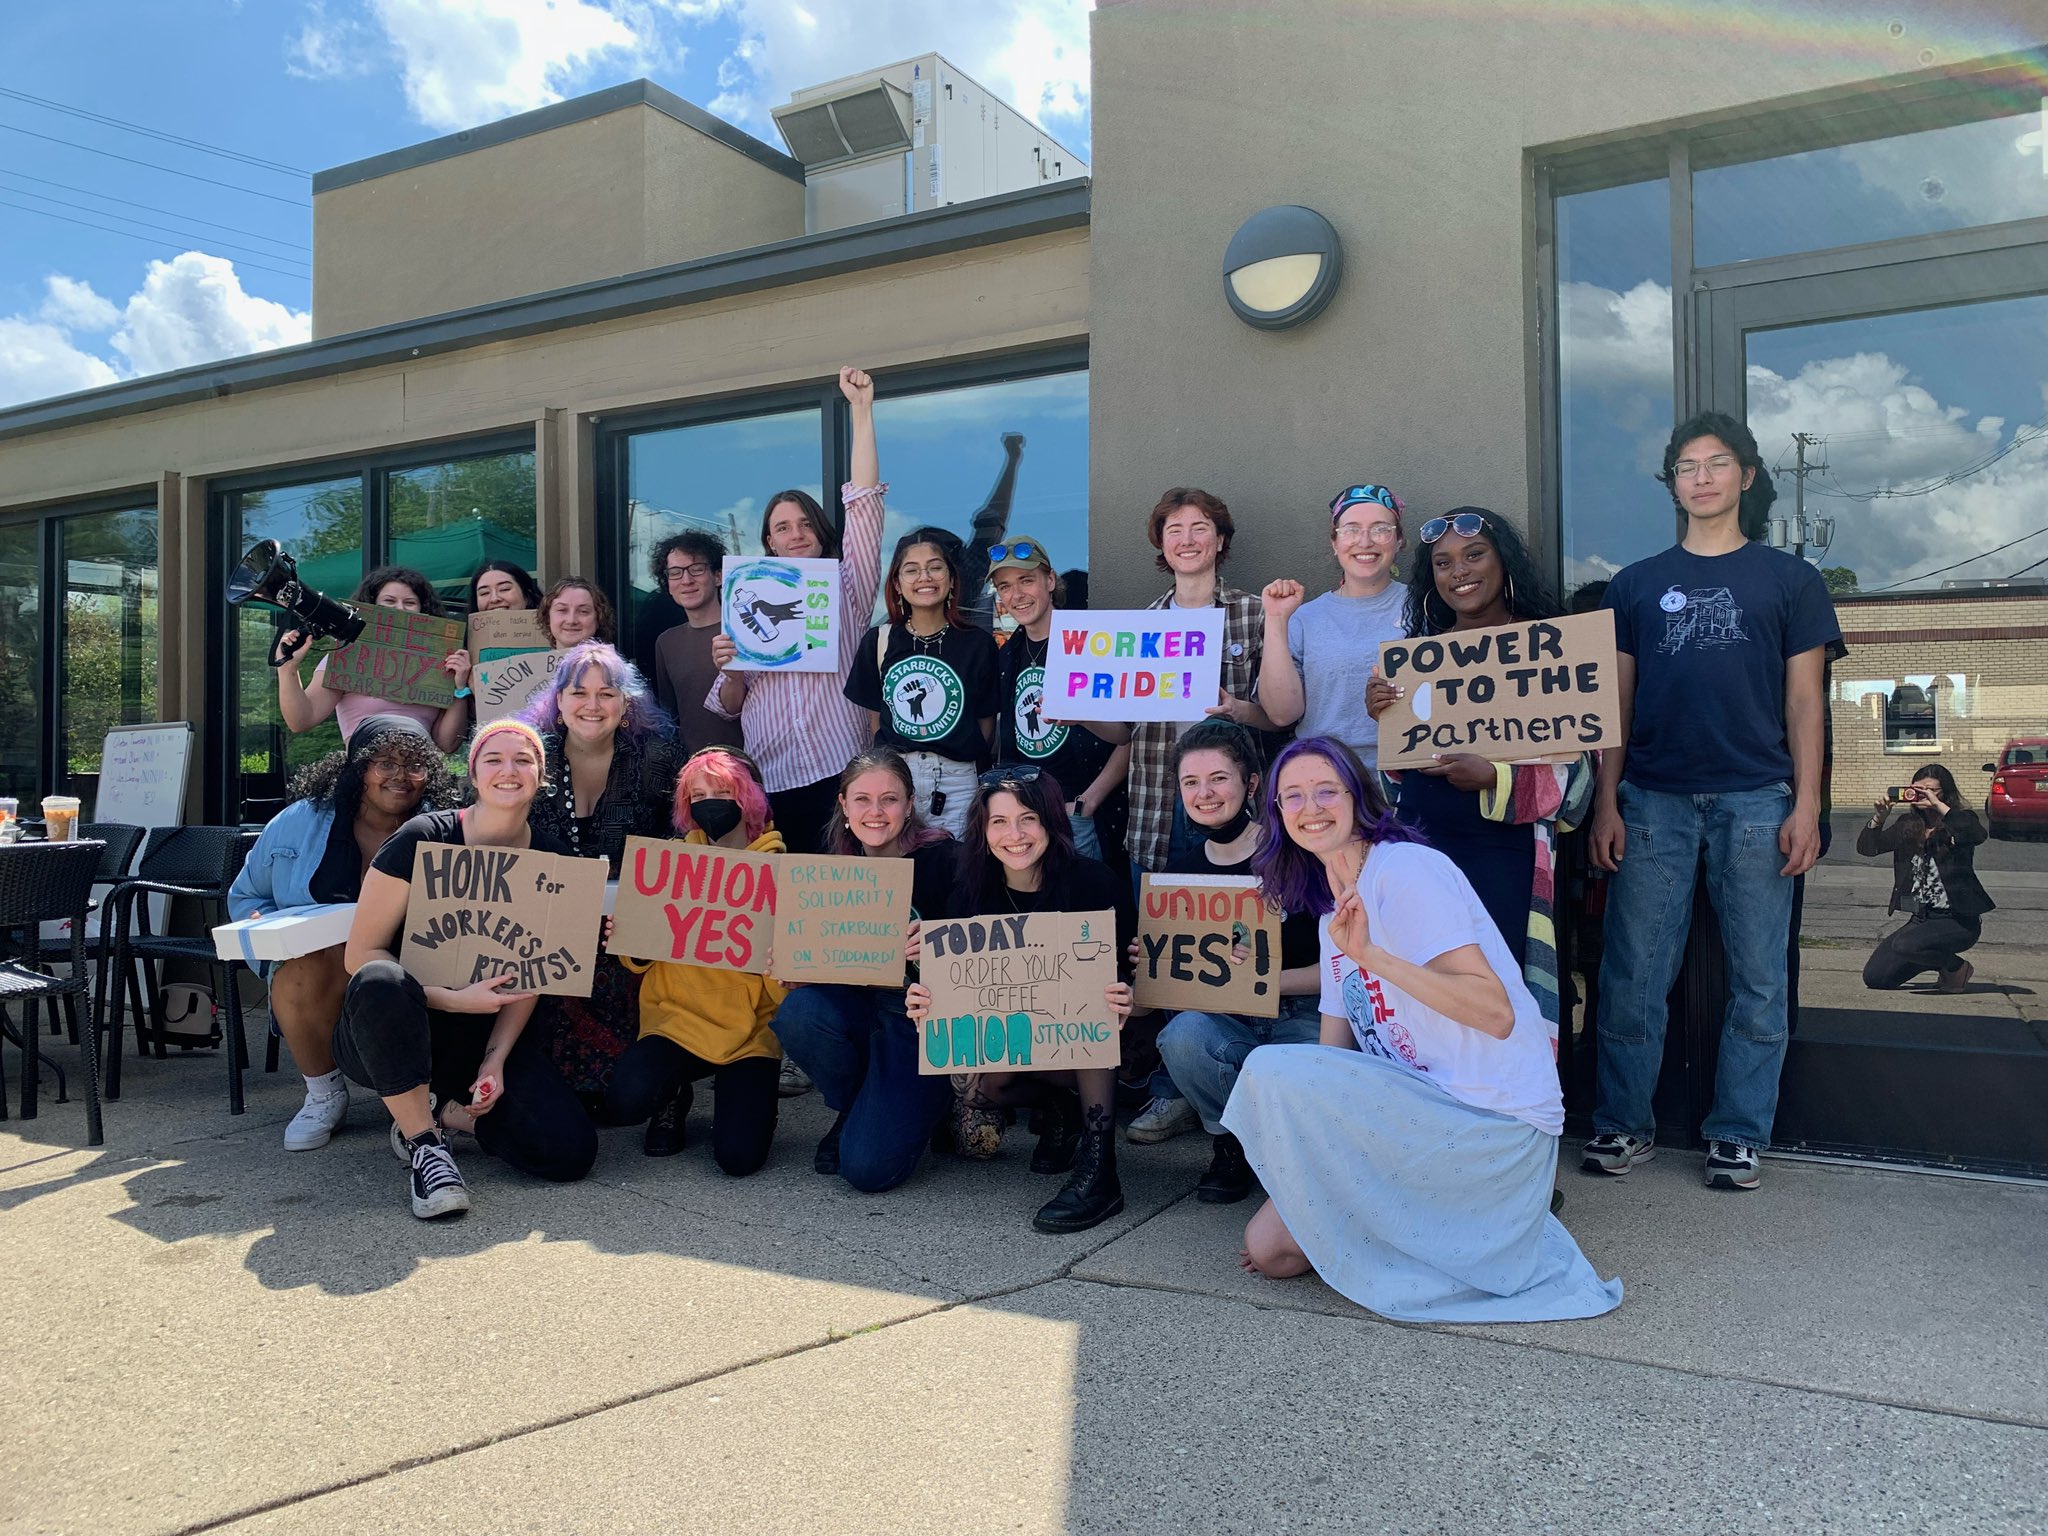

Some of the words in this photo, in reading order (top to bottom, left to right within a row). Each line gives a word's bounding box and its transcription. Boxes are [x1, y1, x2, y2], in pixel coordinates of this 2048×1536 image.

[805, 580, 829, 650] YES!
[332, 640, 437, 686] KRUSTY
[1062, 630, 1206, 659] WORKER
[1383, 622, 1564, 679] POWER
[329, 672, 375, 694] KRAB
[484, 660, 534, 706] UNION
[890, 660, 955, 687] STARBUCKS
[1015, 673, 1044, 695] STARBU
[1067, 671, 1193, 699] PRIDE!
[1436, 675, 1496, 705] TO
[1506, 662, 1599, 698] THE
[886, 696, 918, 736] WKERS
[927, 700, 959, 734] UNITED
[1399, 713, 1603, 754] partners
[1015, 728, 1035, 751] KERS
[1043, 725, 1065, 749] UNIT
[422, 848, 520, 903] HONK
[535, 872, 565, 894] for
[634, 847, 778, 916] UNION
[790, 865, 879, 888] BREWING
[798, 889, 894, 910] SOLIDARITY
[410, 909, 543, 959] WORKER'S
[663, 903, 754, 967] YES
[788, 919, 805, 935] AT
[820, 920, 900, 937] STARBUCKS
[469, 946, 582, 990] RIGHTS!
[792, 949, 811, 963] ON
[950, 956, 1013, 985] ORDER
[1021, 953, 1073, 981] YOUR
[1143, 929, 1271, 996] YES!
[978, 985, 1045, 1012] COFFEE
[925, 1012, 1033, 1068] UNION
[1034, 1022, 1112, 1046] STRONG
